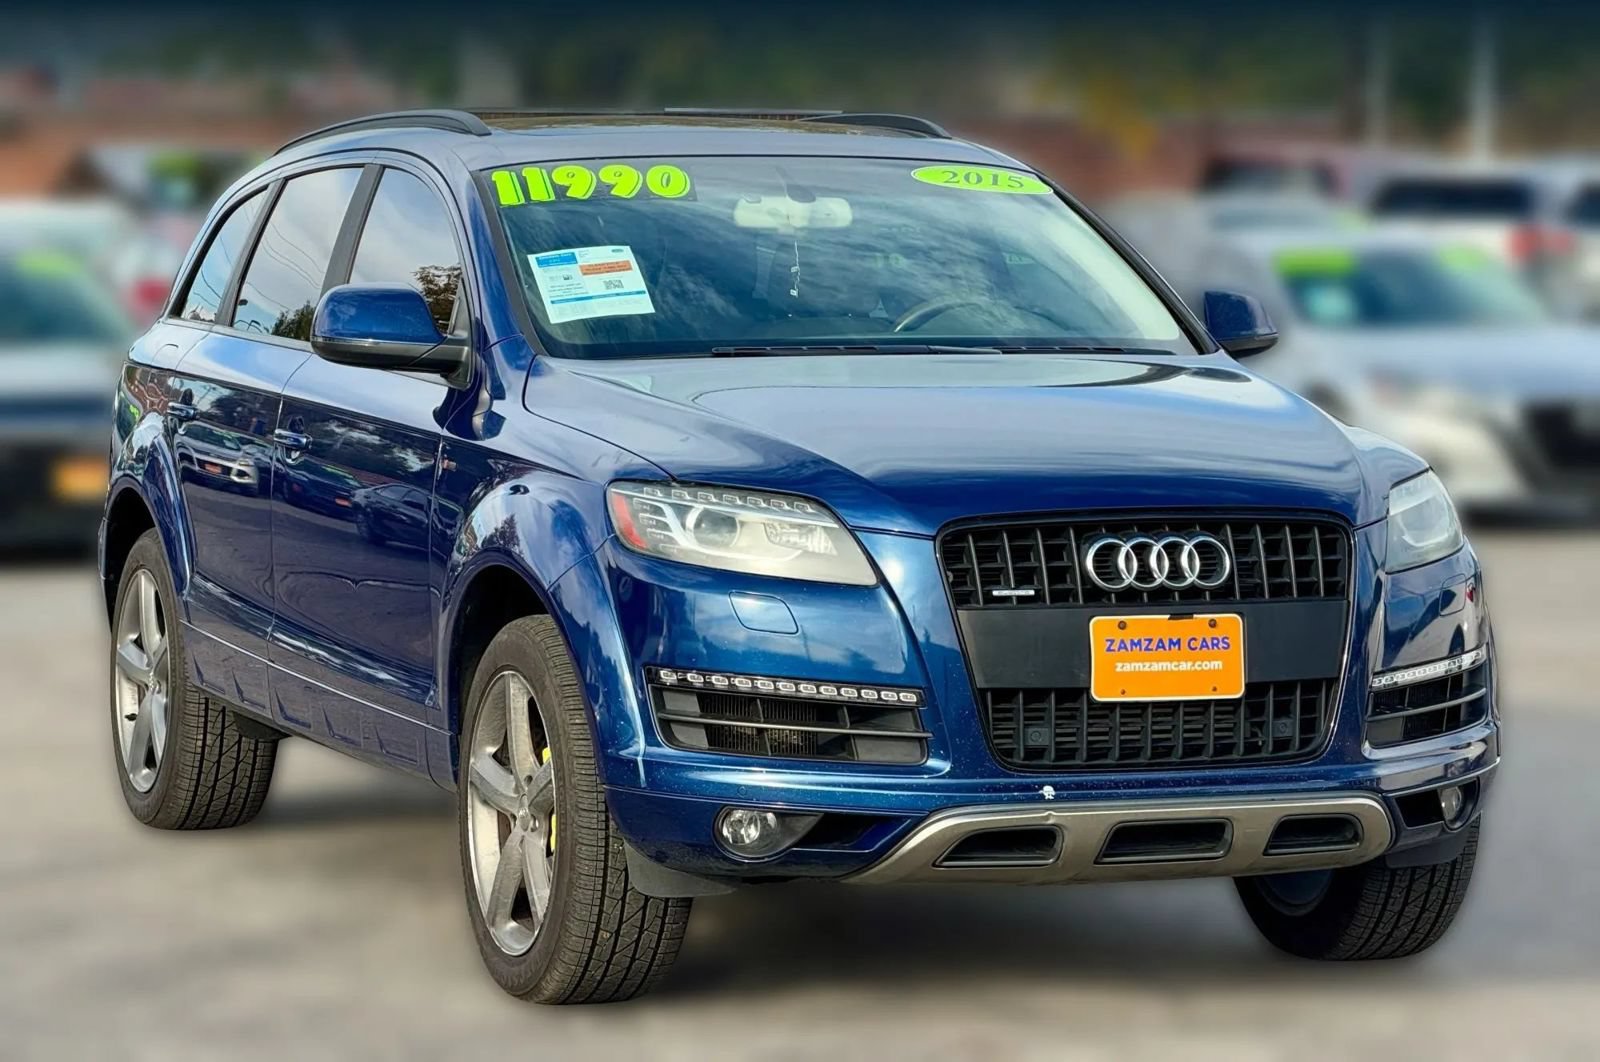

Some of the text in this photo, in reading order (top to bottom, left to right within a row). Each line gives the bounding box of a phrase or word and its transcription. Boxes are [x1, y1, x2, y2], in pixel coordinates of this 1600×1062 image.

[491, 164, 690, 206] 11990
[941, 170, 1024, 188] 2015
[1105, 636, 1231, 652] ZAMZAM CARS
[1115, 660, 1223, 672] zamzamcar.com
